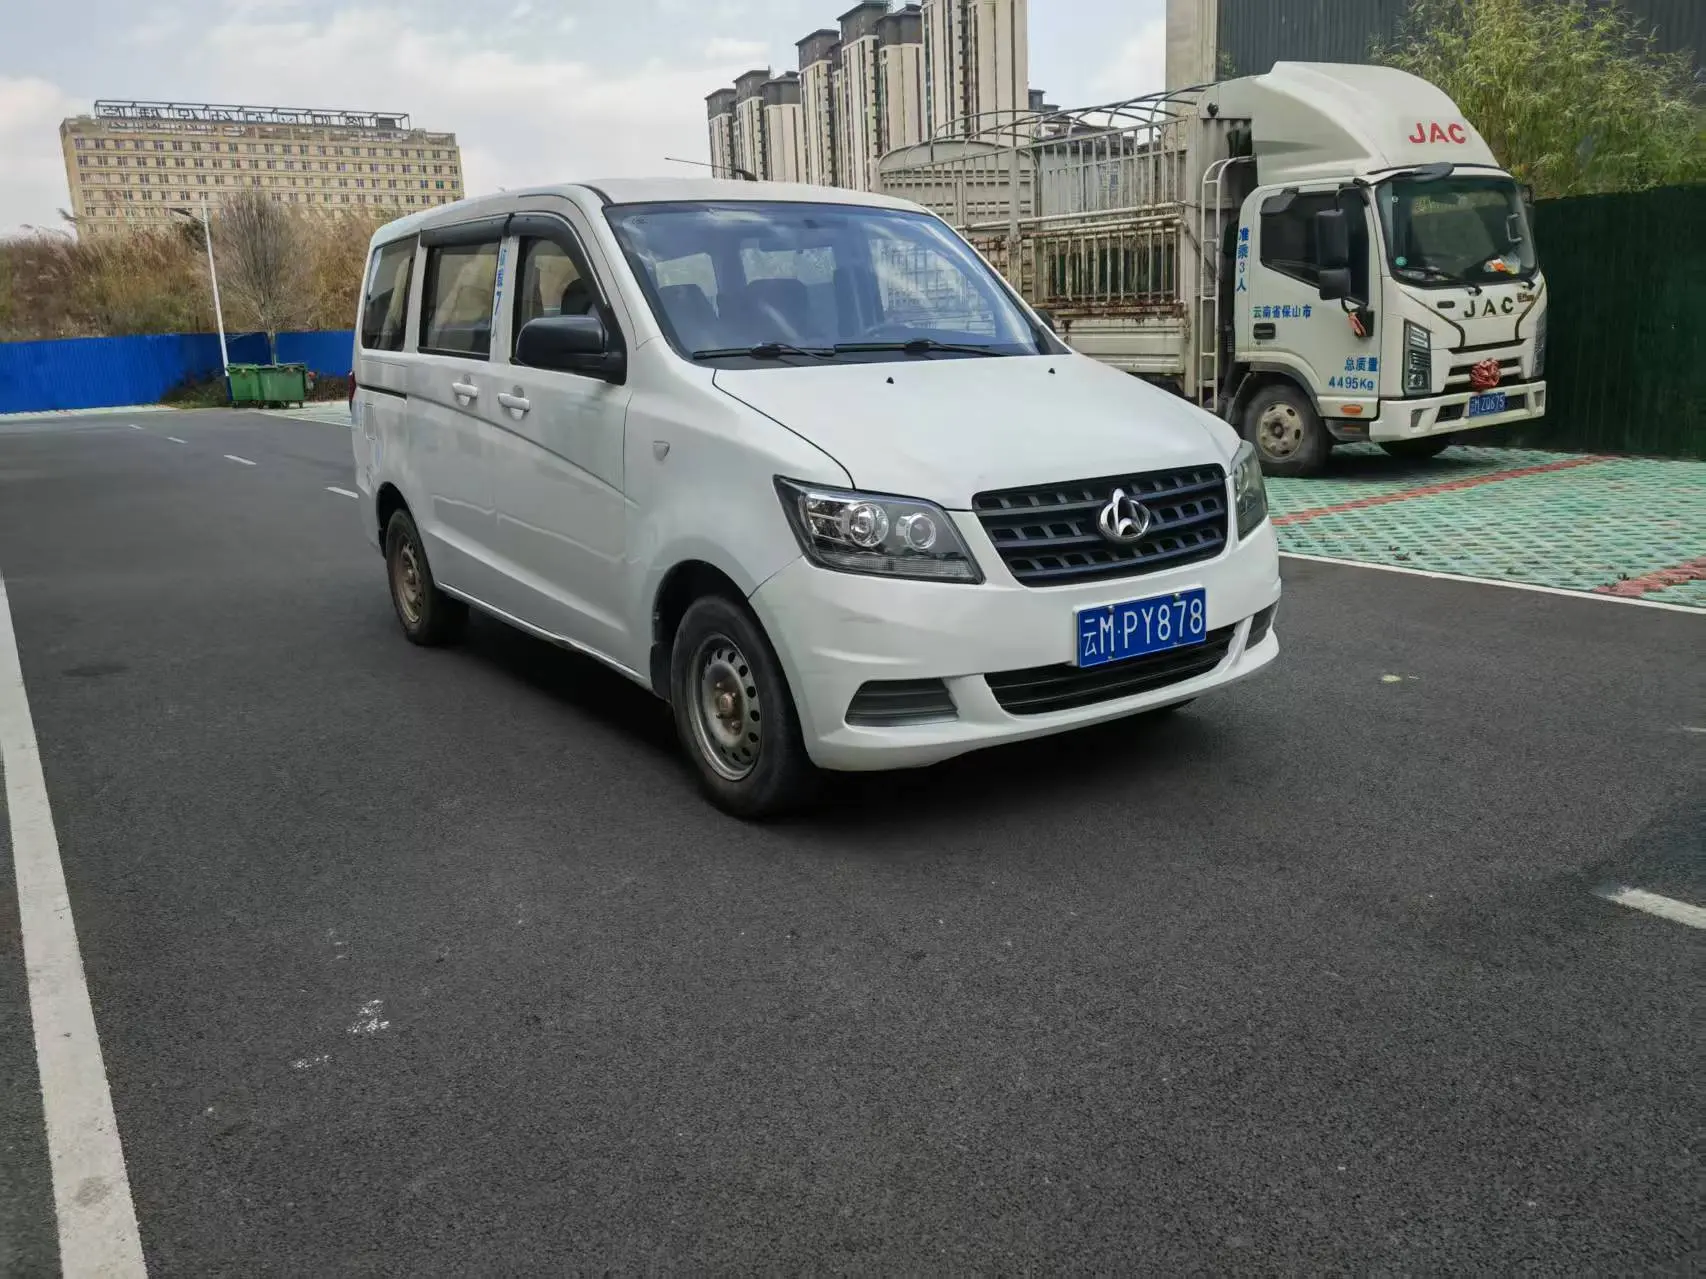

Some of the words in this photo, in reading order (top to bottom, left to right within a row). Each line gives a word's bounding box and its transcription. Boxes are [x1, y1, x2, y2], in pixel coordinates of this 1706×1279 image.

[1408, 122, 1466, 144] JAC
[1253, 304, 1312, 319] 云南省保山市
[1463, 296, 1514, 318] JAC
[1345, 356, 1378, 372] 总质量
[1328, 375, 1374, 391] 4495Kg
